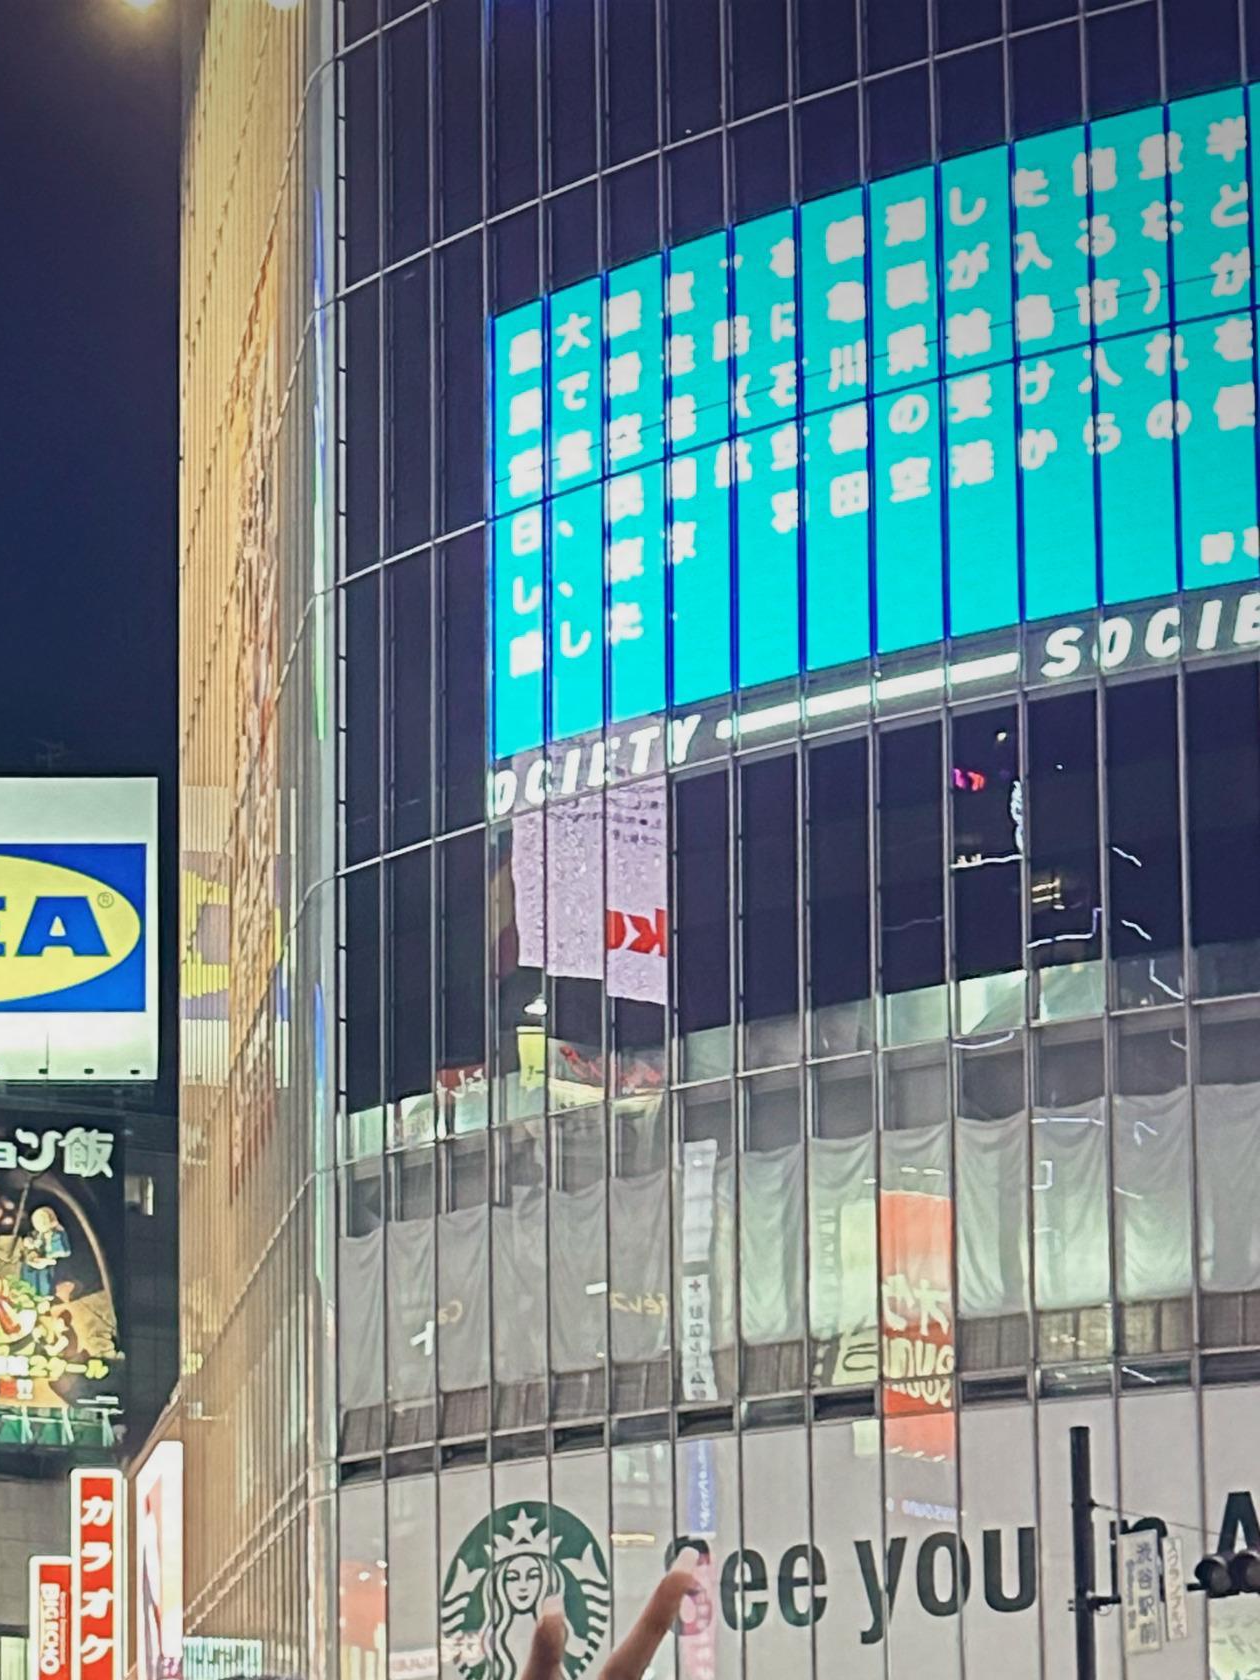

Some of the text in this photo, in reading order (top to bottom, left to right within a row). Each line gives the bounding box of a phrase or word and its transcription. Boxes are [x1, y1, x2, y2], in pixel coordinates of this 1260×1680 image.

[39, 1583, 60, 1620] BIG
[80, 1495, 114, 1665] カラオケ
[853, 1525, 1037, 1646] you
